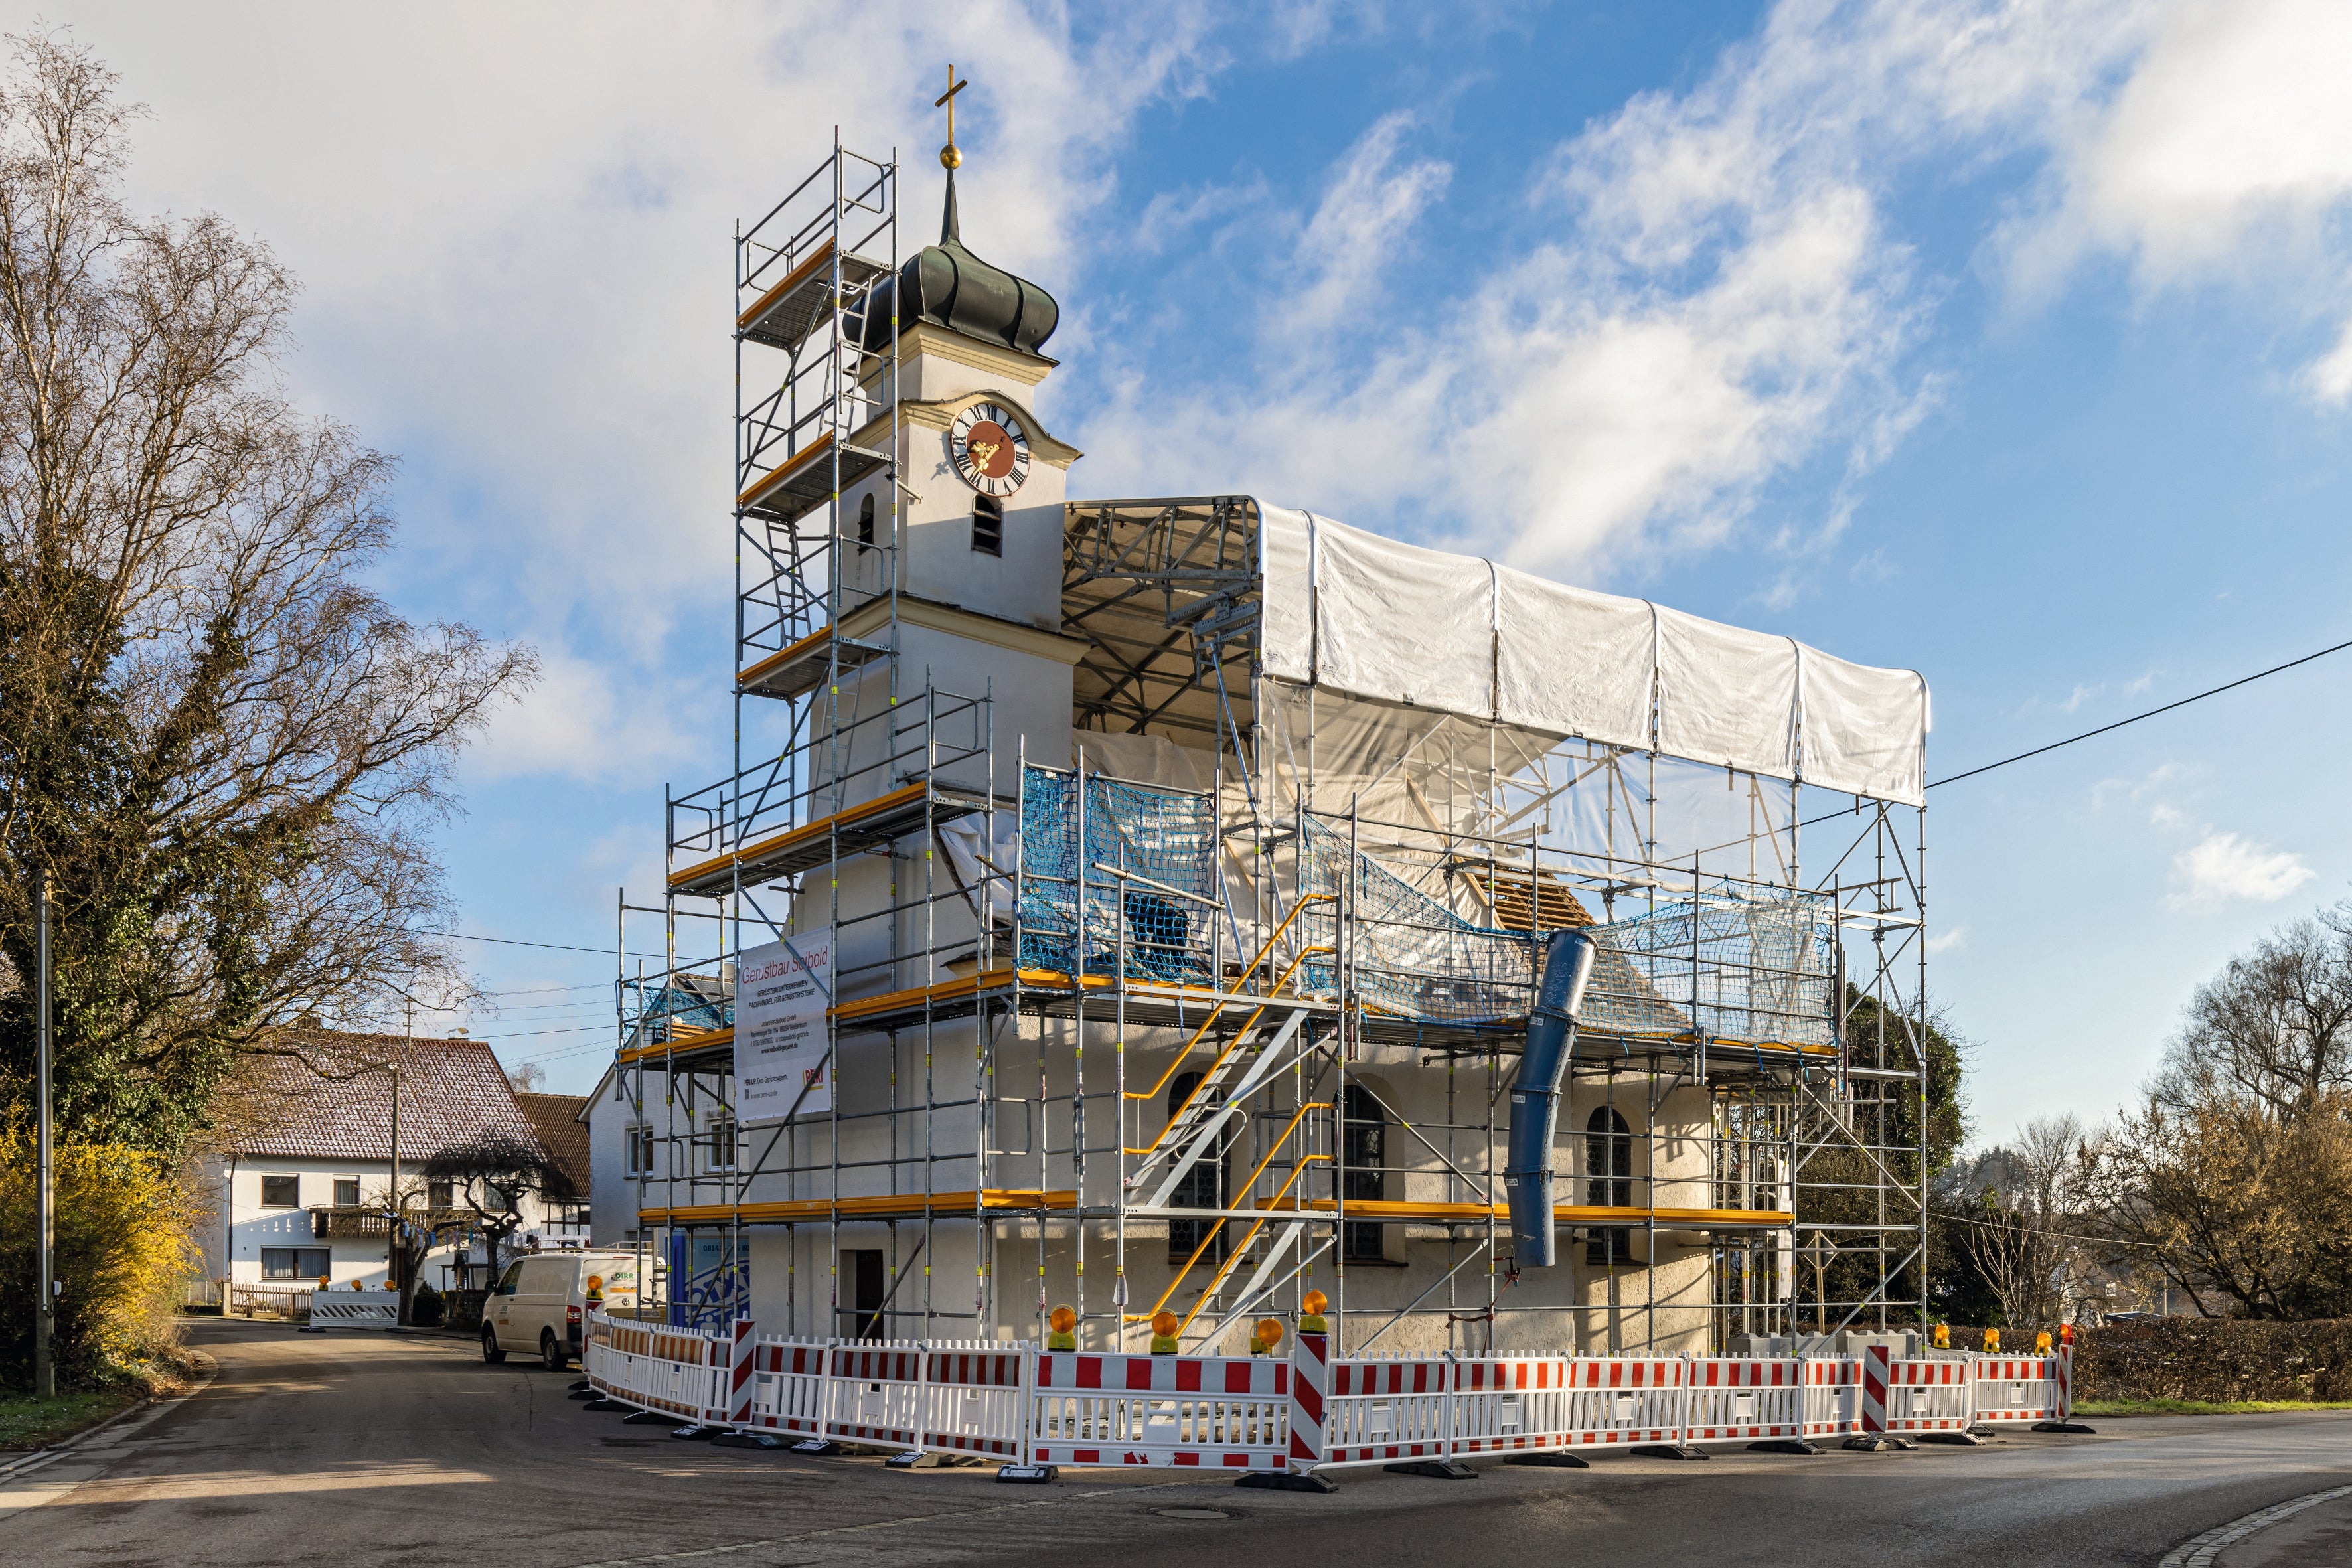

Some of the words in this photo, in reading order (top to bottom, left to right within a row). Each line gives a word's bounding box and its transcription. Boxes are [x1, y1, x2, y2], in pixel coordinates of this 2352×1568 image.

[985, 404, 998, 422] XII
[742, 960, 789, 984] Gerüstbau
[749, 998, 773, 1008] FACHHANDEL
[781, 988, 815, 1001] GERÜSTSYSTEME
[757, 980, 808, 997] GERÜSTBAUUNTERNEHMEN
